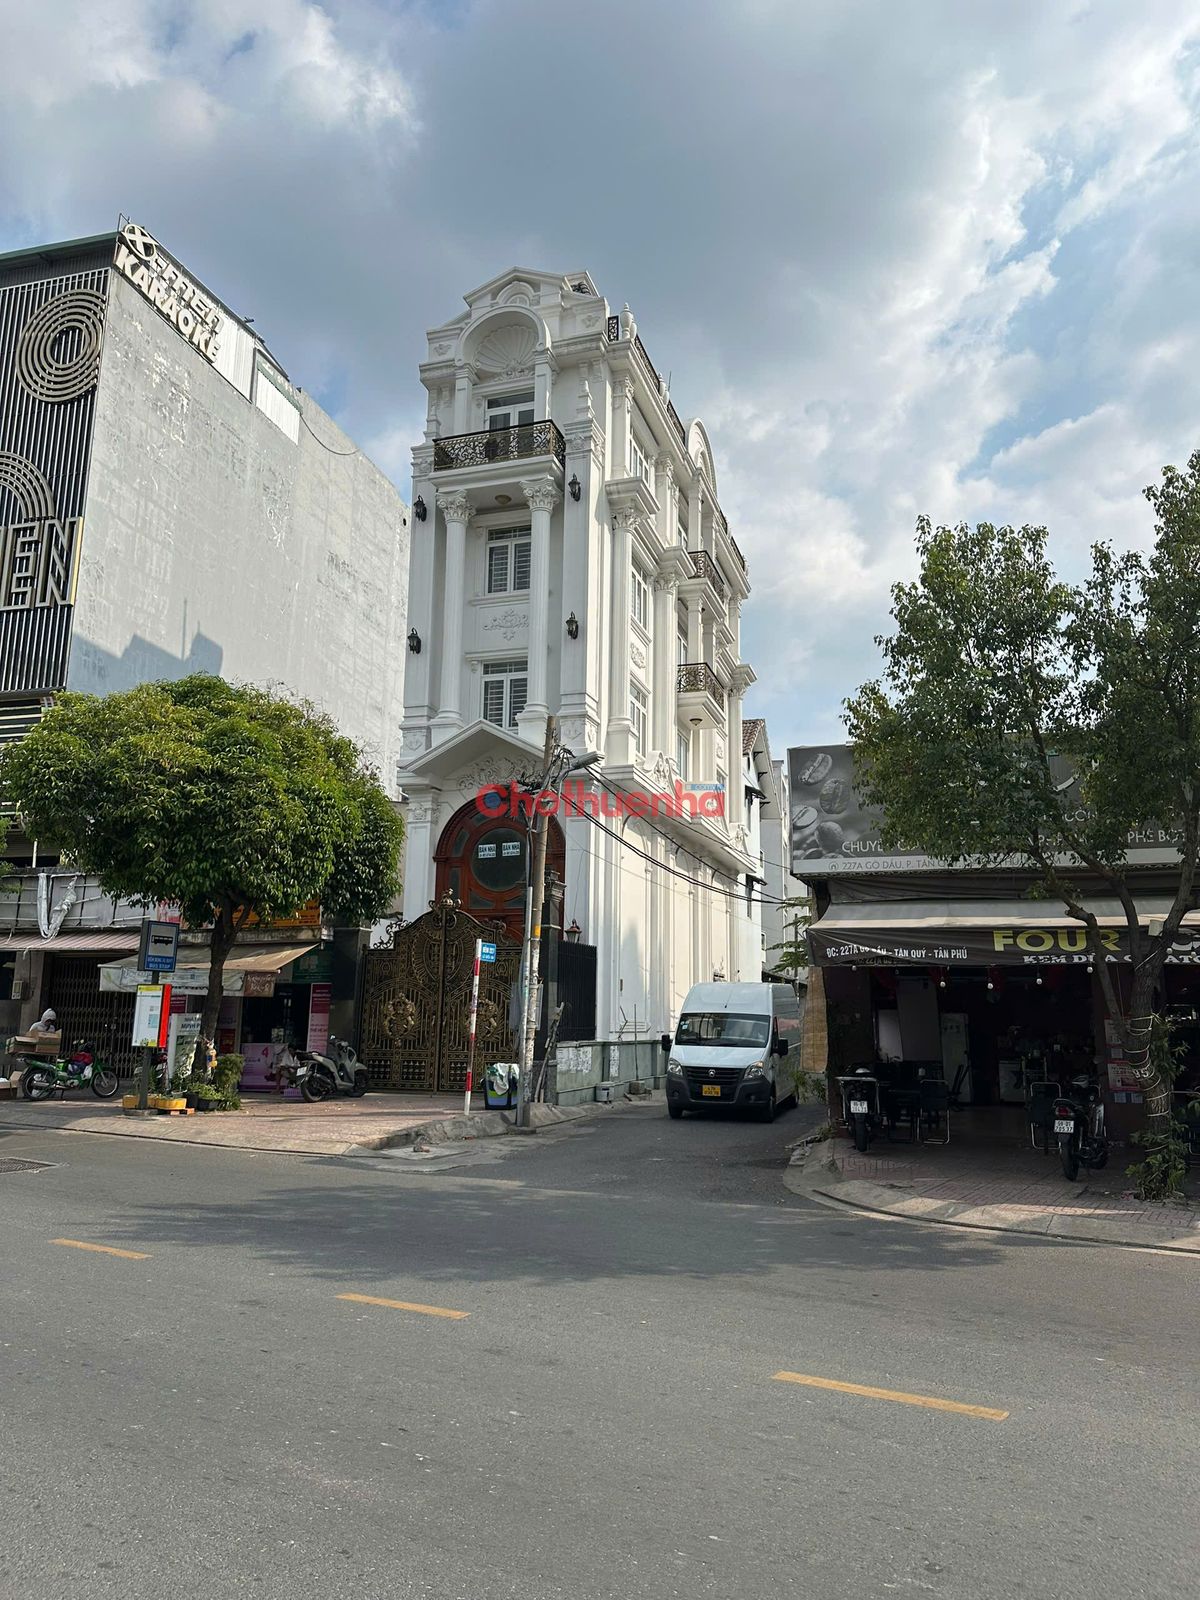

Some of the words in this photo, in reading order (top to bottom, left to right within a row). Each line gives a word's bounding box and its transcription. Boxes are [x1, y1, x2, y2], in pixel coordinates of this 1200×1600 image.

[115, 243, 221, 364] KARAOKE
[842, 861, 863, 870] 227A
[993, 928, 1122, 951] FOUR
[840, 944, 859, 956] 227A
[911, 947, 927, 958] QUÝ
[933, 946, 949, 959] TÂN
[951, 946, 968, 959] PHÚ
